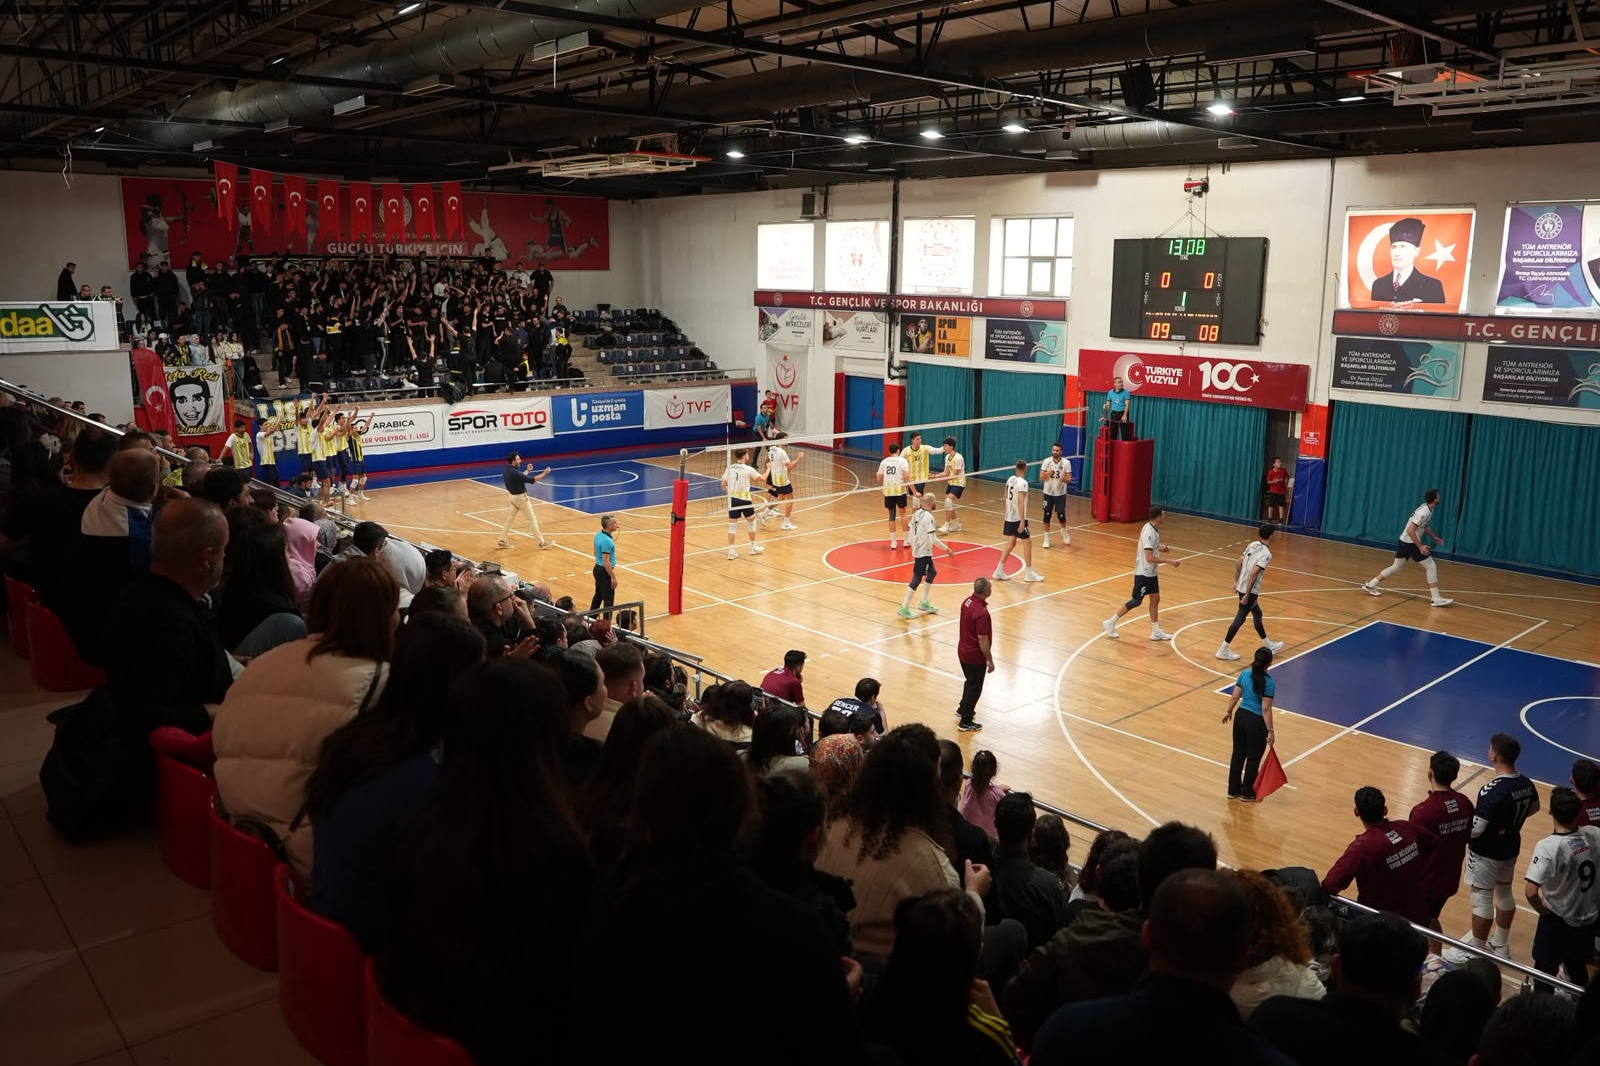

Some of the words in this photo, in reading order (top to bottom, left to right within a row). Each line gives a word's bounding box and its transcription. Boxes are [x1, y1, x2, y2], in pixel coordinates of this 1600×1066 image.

[1161, 272, 1171, 288] 0
[1204, 272, 1214, 289] 0
[809, 296, 826, 306] T.C.
[829, 295, 871, 309] GENÇLİK
[874, 298, 886, 308] VE
[890, 299, 917, 310] SPOR
[919, 300, 983, 313] BAKANLIĞI
[1181, 291, 1186, 307] 1
[1151, 322, 1170, 338] 09
[1199, 324, 1219, 341] 08
[1465, 322, 1501, 337] T.C.
[1510, 324, 1600, 342] GENÇLİ
[1503, 367, 1560, 376] SPORCULARIMIZA
[591, 403, 627, 413] uzman
[686, 400, 711, 413] TVF
[372, 419, 415, 430] ARABICA
[448, 414, 498, 431] SPOR
[500, 410, 547, 427] TOTO
[592, 412, 622, 424] posta
[374, 434, 407, 443] VOLEYBOL
[417, 432, 430, 440] LİGİ
[886, 466, 897, 475] 20
[1050, 470, 1061, 479] 23
[833, 700, 860, 712] SENCER
[1578, 860, 1595, 893] 9
